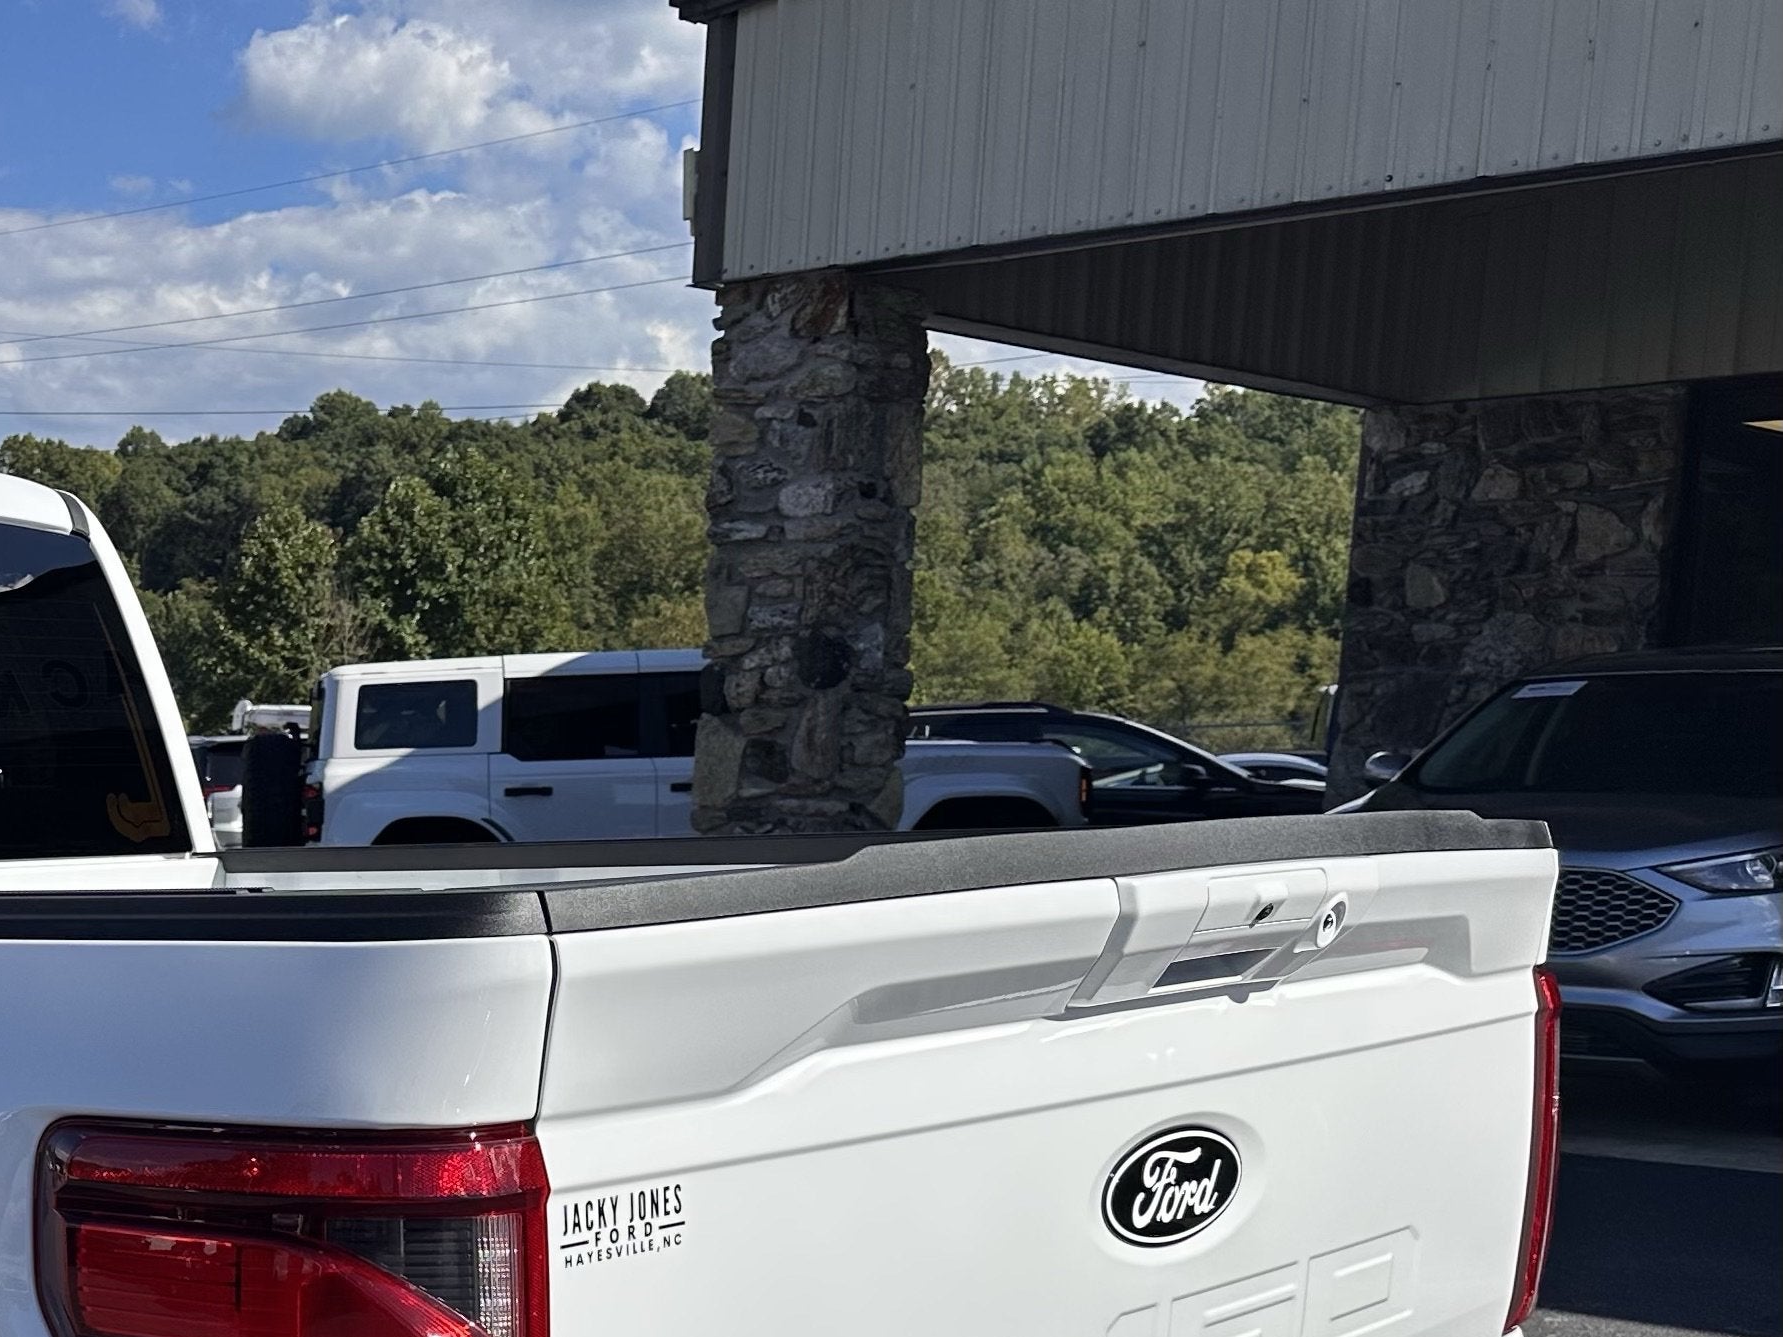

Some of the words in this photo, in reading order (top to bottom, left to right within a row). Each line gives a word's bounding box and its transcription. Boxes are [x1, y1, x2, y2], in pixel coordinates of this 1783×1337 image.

[562, 1195, 619, 1236] JACKY
[629, 1184, 682, 1224] JONES
[1130, 1145, 1220, 1229] Ford
[594, 1222, 653, 1247] FORD
